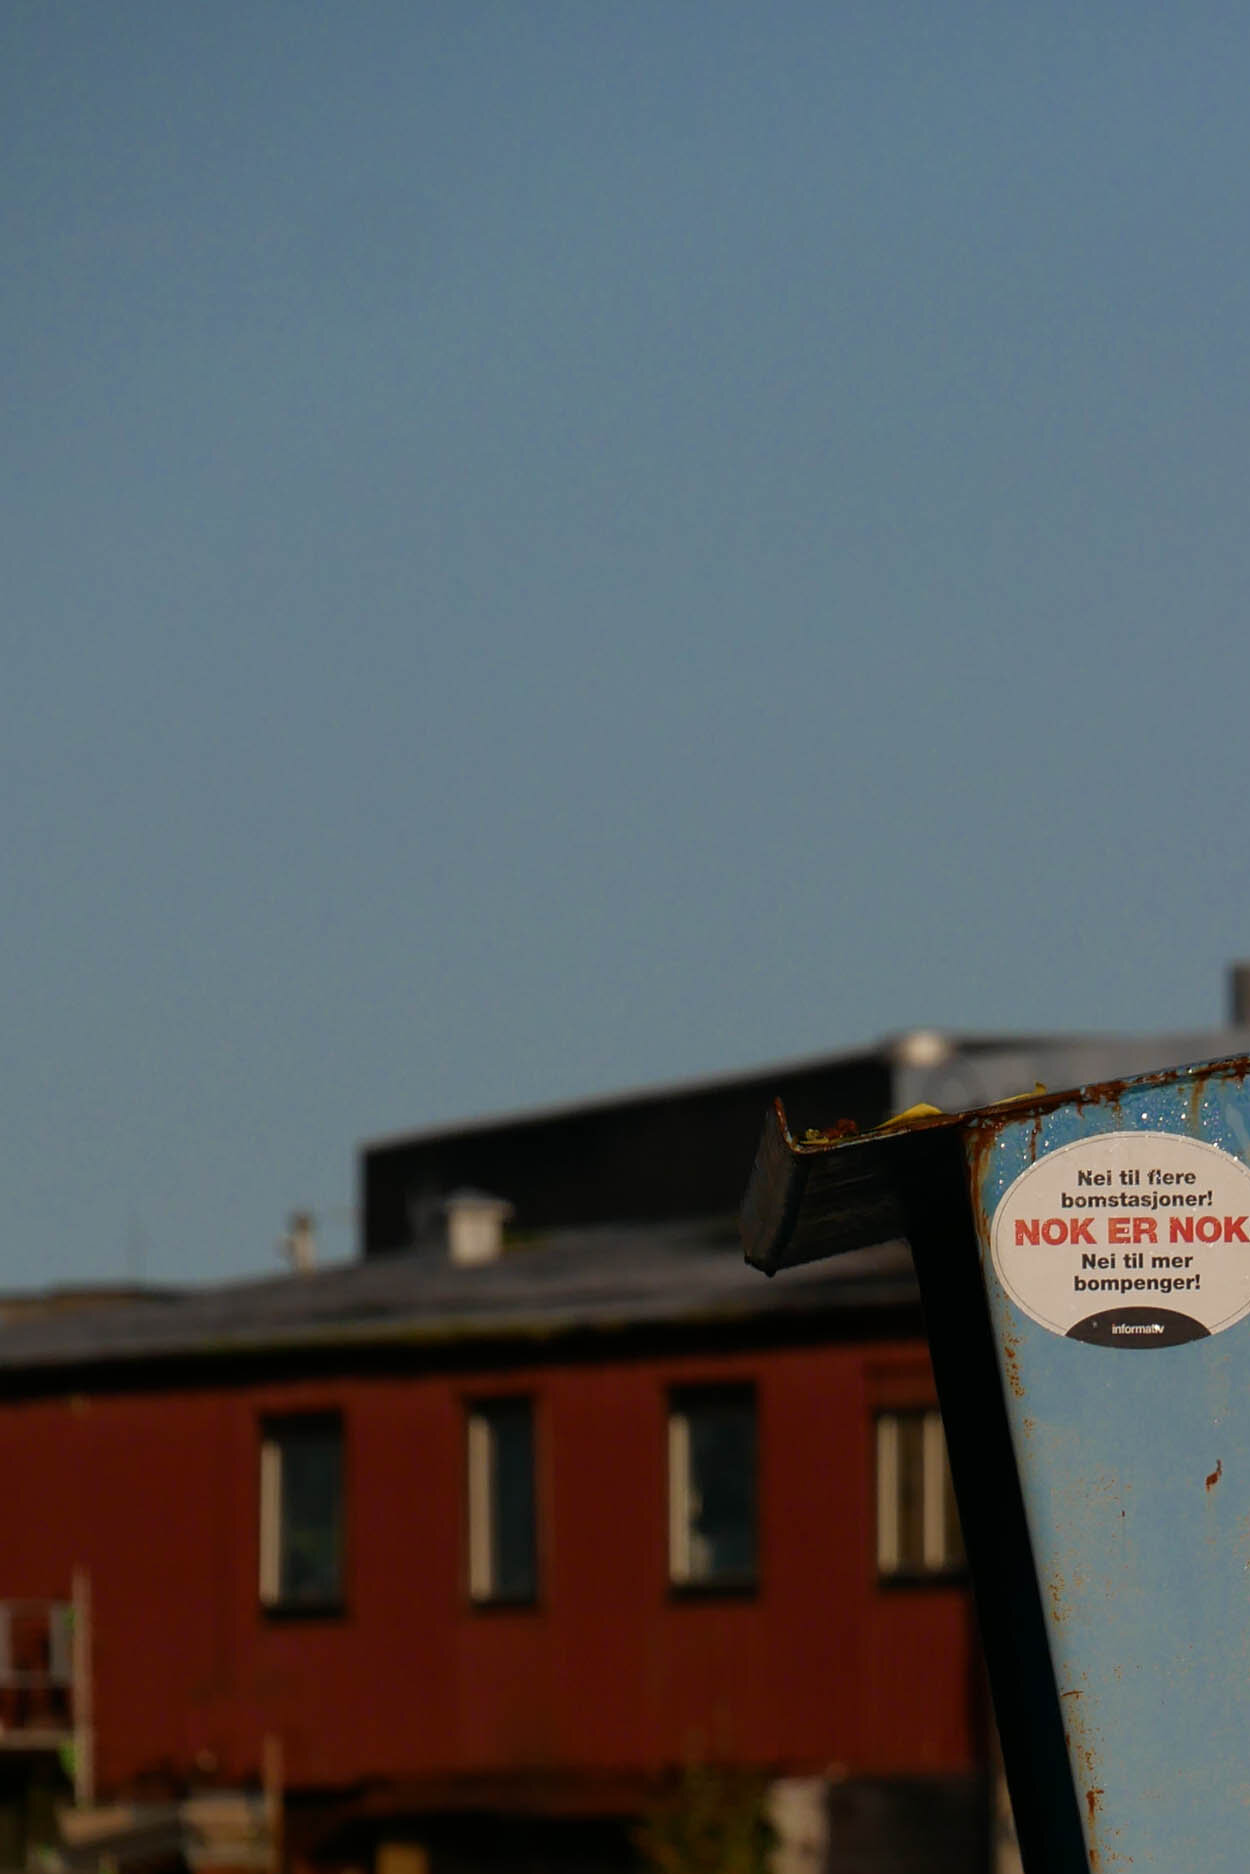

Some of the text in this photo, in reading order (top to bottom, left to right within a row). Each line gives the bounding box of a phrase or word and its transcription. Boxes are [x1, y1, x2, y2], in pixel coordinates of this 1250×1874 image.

[1077, 1169, 1196, 1186] Nei til flere
[1061, 1191, 1213, 1210] bomstasjoner!
[1015, 1218, 1097, 1246] NOK
[1108, 1217, 1158, 1244] ER
[1081, 1253, 1193, 1269] Nei til mer
[1074, 1275, 1200, 1293] bompenger!
[1111, 1323, 1164, 1335] informativ
